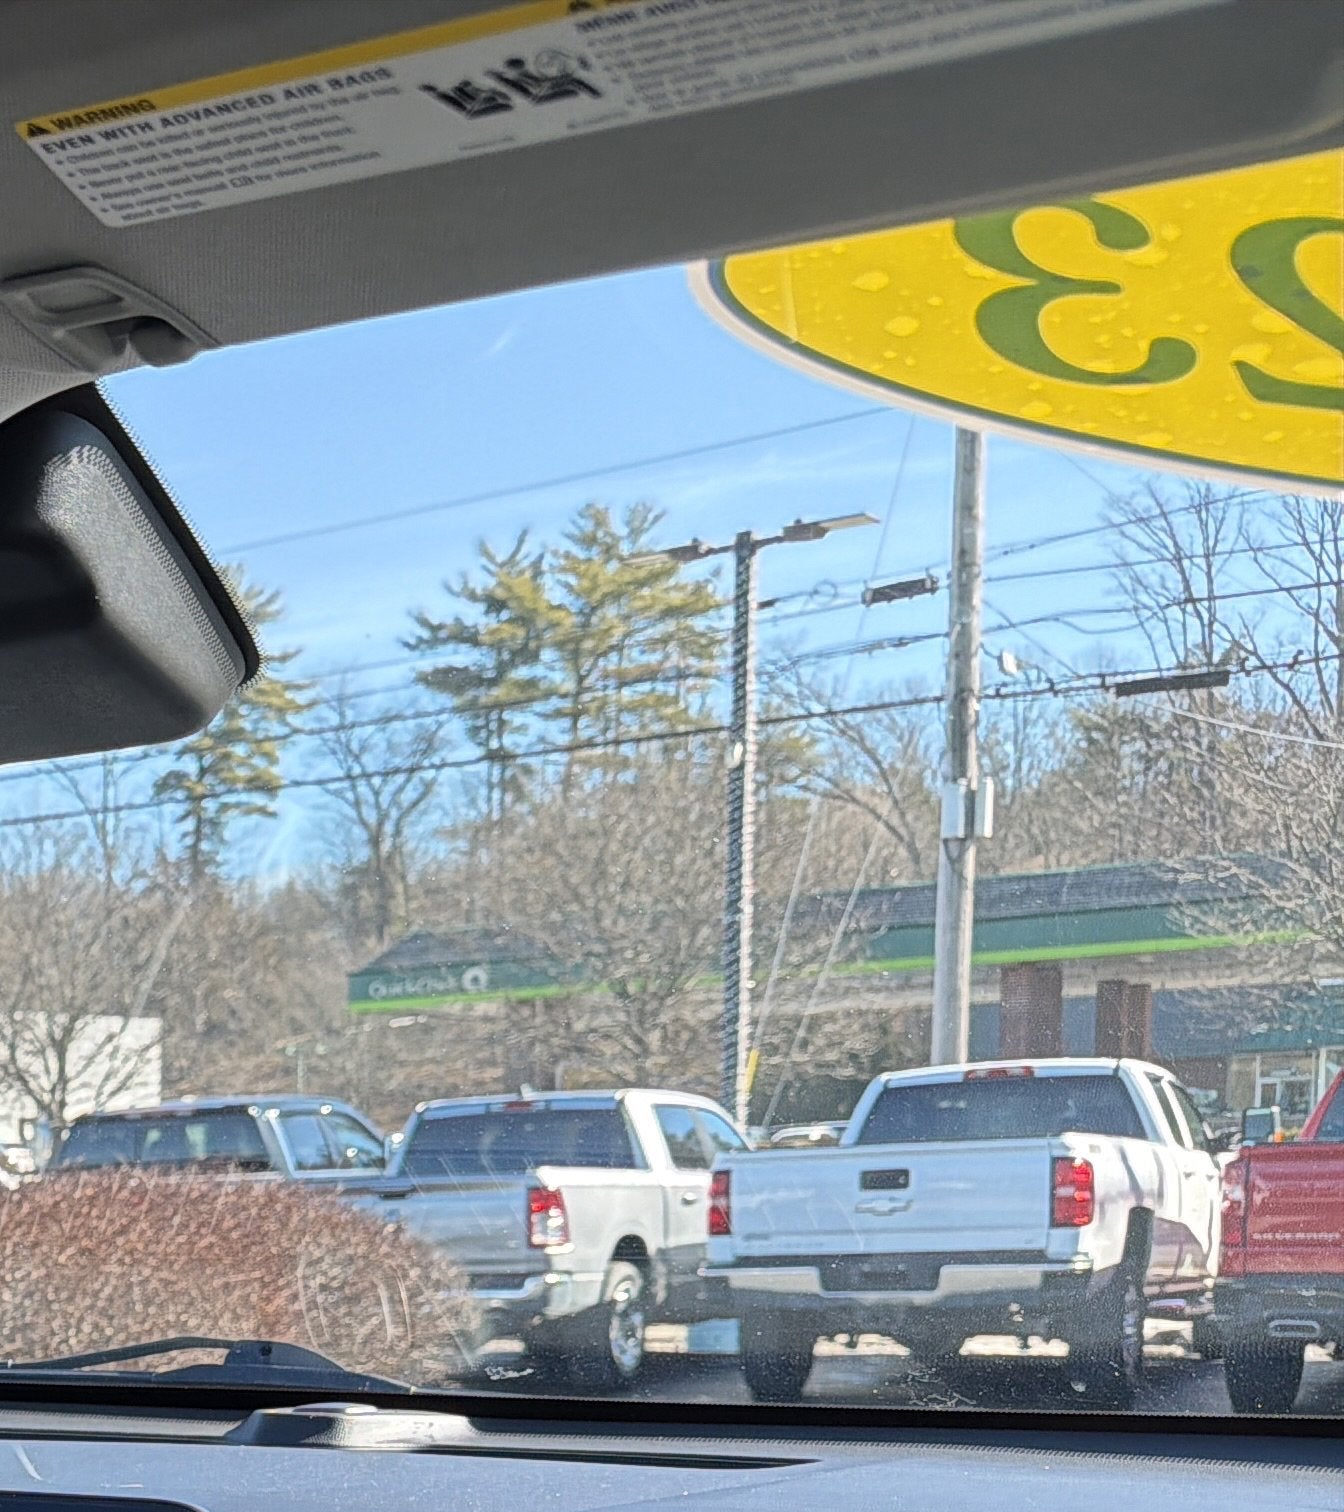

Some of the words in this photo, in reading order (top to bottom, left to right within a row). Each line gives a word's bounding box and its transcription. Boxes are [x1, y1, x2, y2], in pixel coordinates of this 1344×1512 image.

[40, 133, 96, 154] EVEN
[98, 120, 155, 141] WITH
[157, 92, 276, 128] ADVANCED
[279, 82, 322, 100] AIR
[326, 66, 392, 90] BAGS
[50, 99, 156, 130] WARNING
